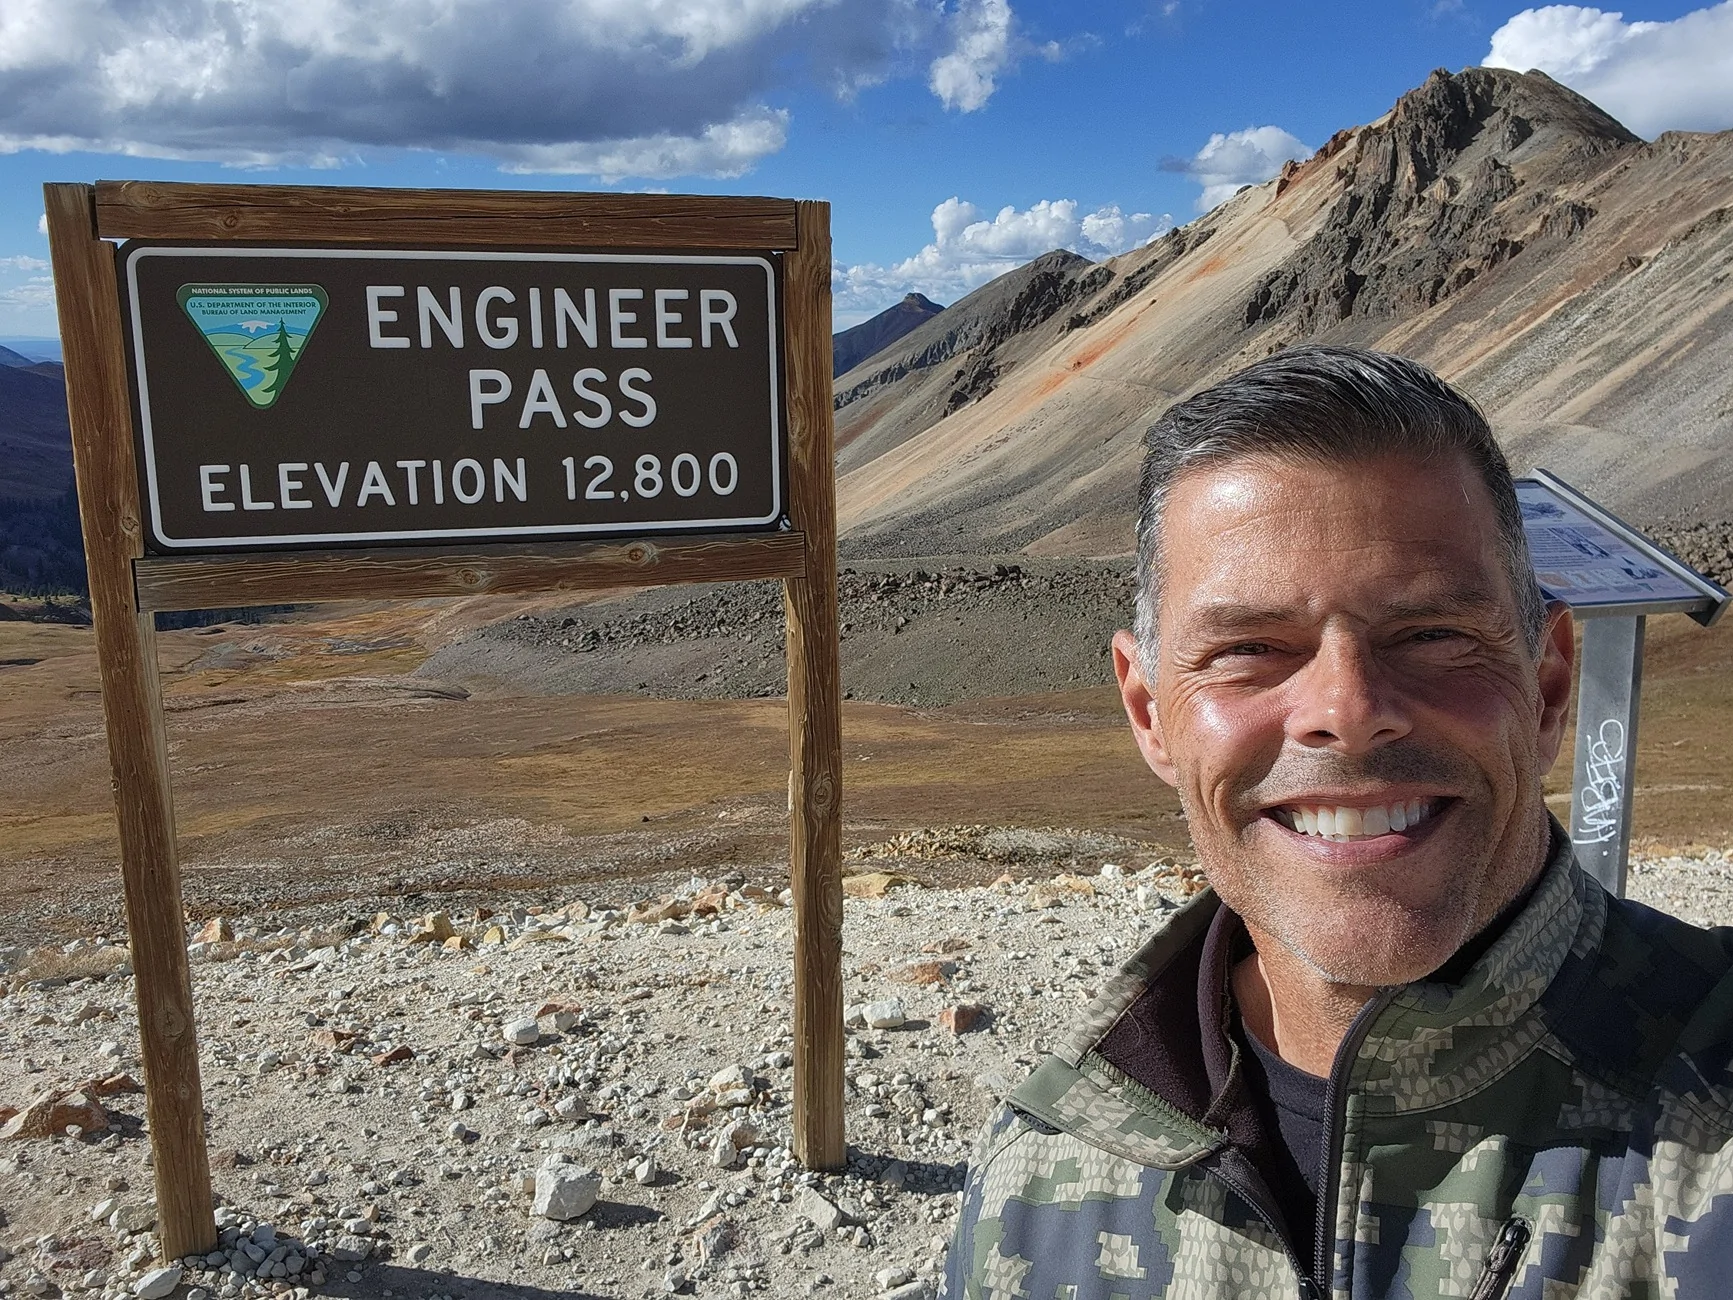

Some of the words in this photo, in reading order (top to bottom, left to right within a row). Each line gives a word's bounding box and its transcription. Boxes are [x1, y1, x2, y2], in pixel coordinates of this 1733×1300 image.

[190, 301, 205, 309] U.S.
[191, 287, 227, 295] NATIONAL
[228, 287, 253, 295] SYSTEM
[365, 285, 740, 350] ENGINEER
[468, 366, 658, 430] PASS
[198, 457, 528, 513] ELEVATION
[562, 452, 739, 503] 12,800
